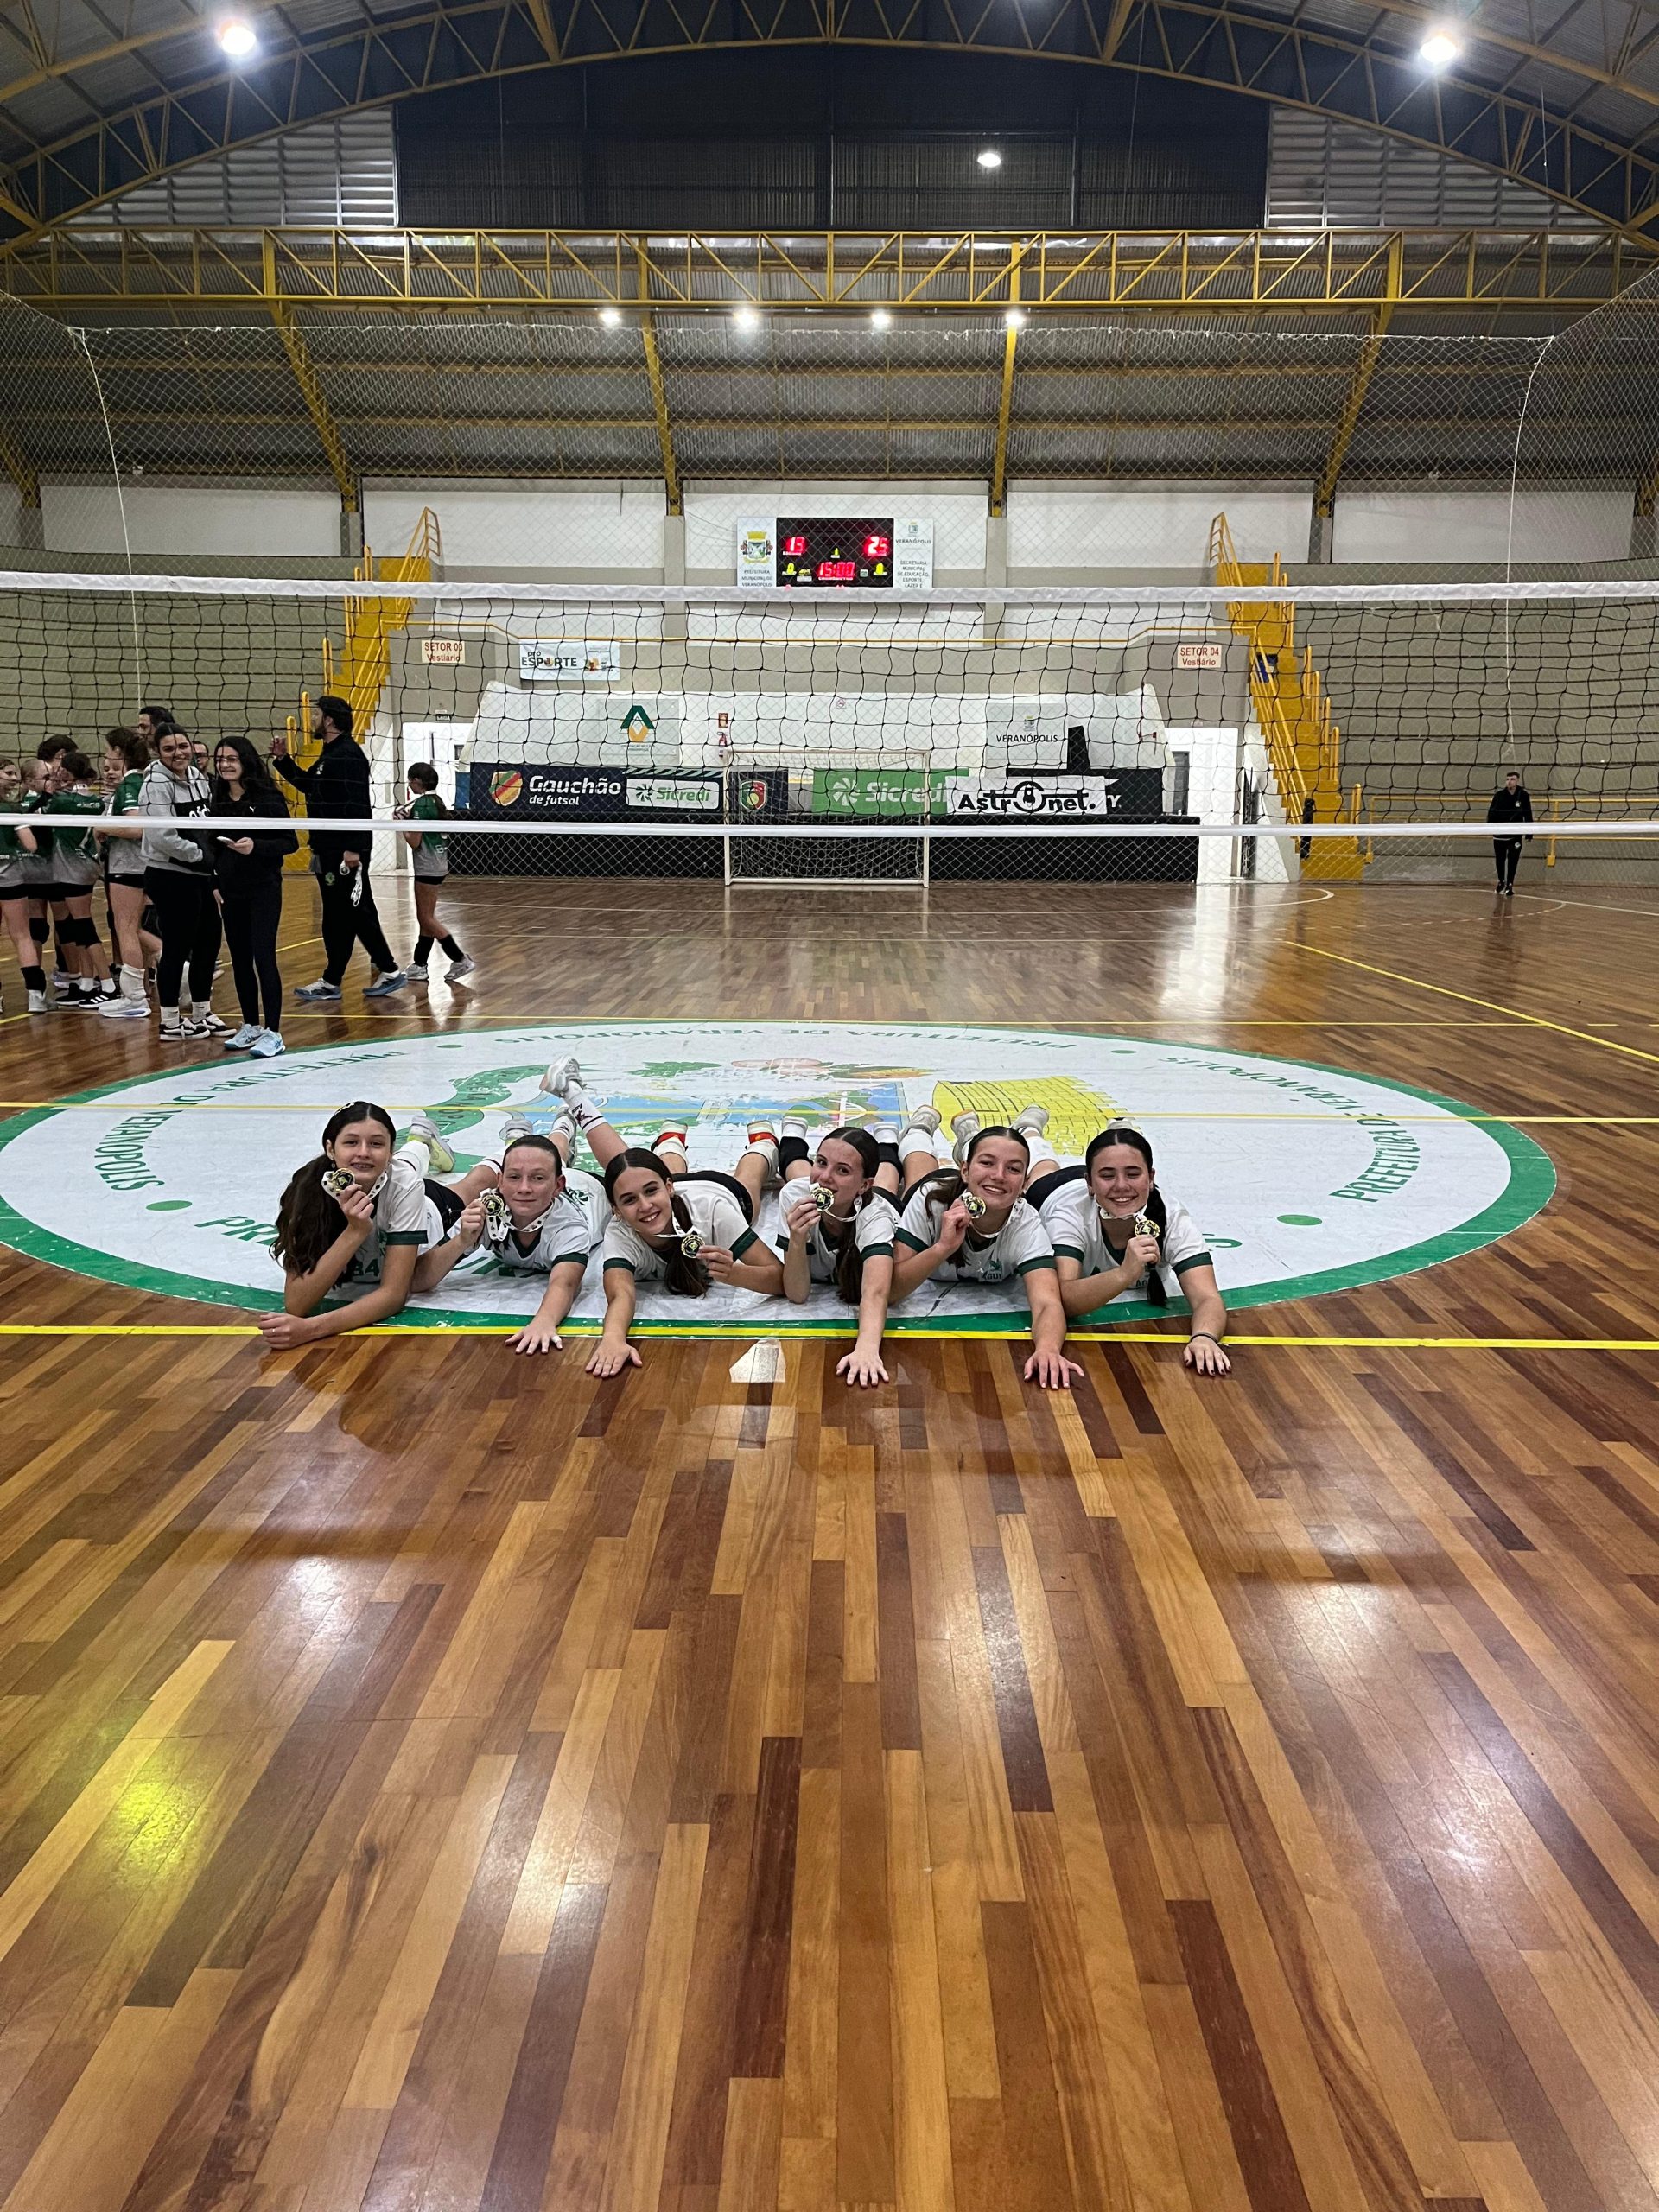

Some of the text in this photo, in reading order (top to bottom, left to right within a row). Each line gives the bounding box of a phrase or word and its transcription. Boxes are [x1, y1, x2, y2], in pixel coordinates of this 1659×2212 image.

[819, 562, 855, 577] 15:00
[424, 642, 452, 652] SETOR
[1179, 647, 1219, 657] SETOR 04
[427, 653, 460, 662] Vestiário
[1182, 658, 1217, 666] Vestiário
[995, 733, 1058, 743] VERANÓPOLIS
[529, 775, 621, 795] Gauchão
[656, 786, 711, 802] Sicredi
[529, 795, 580, 806] de futsal
[1328, 1129, 1421, 1203] PREFEITURA
